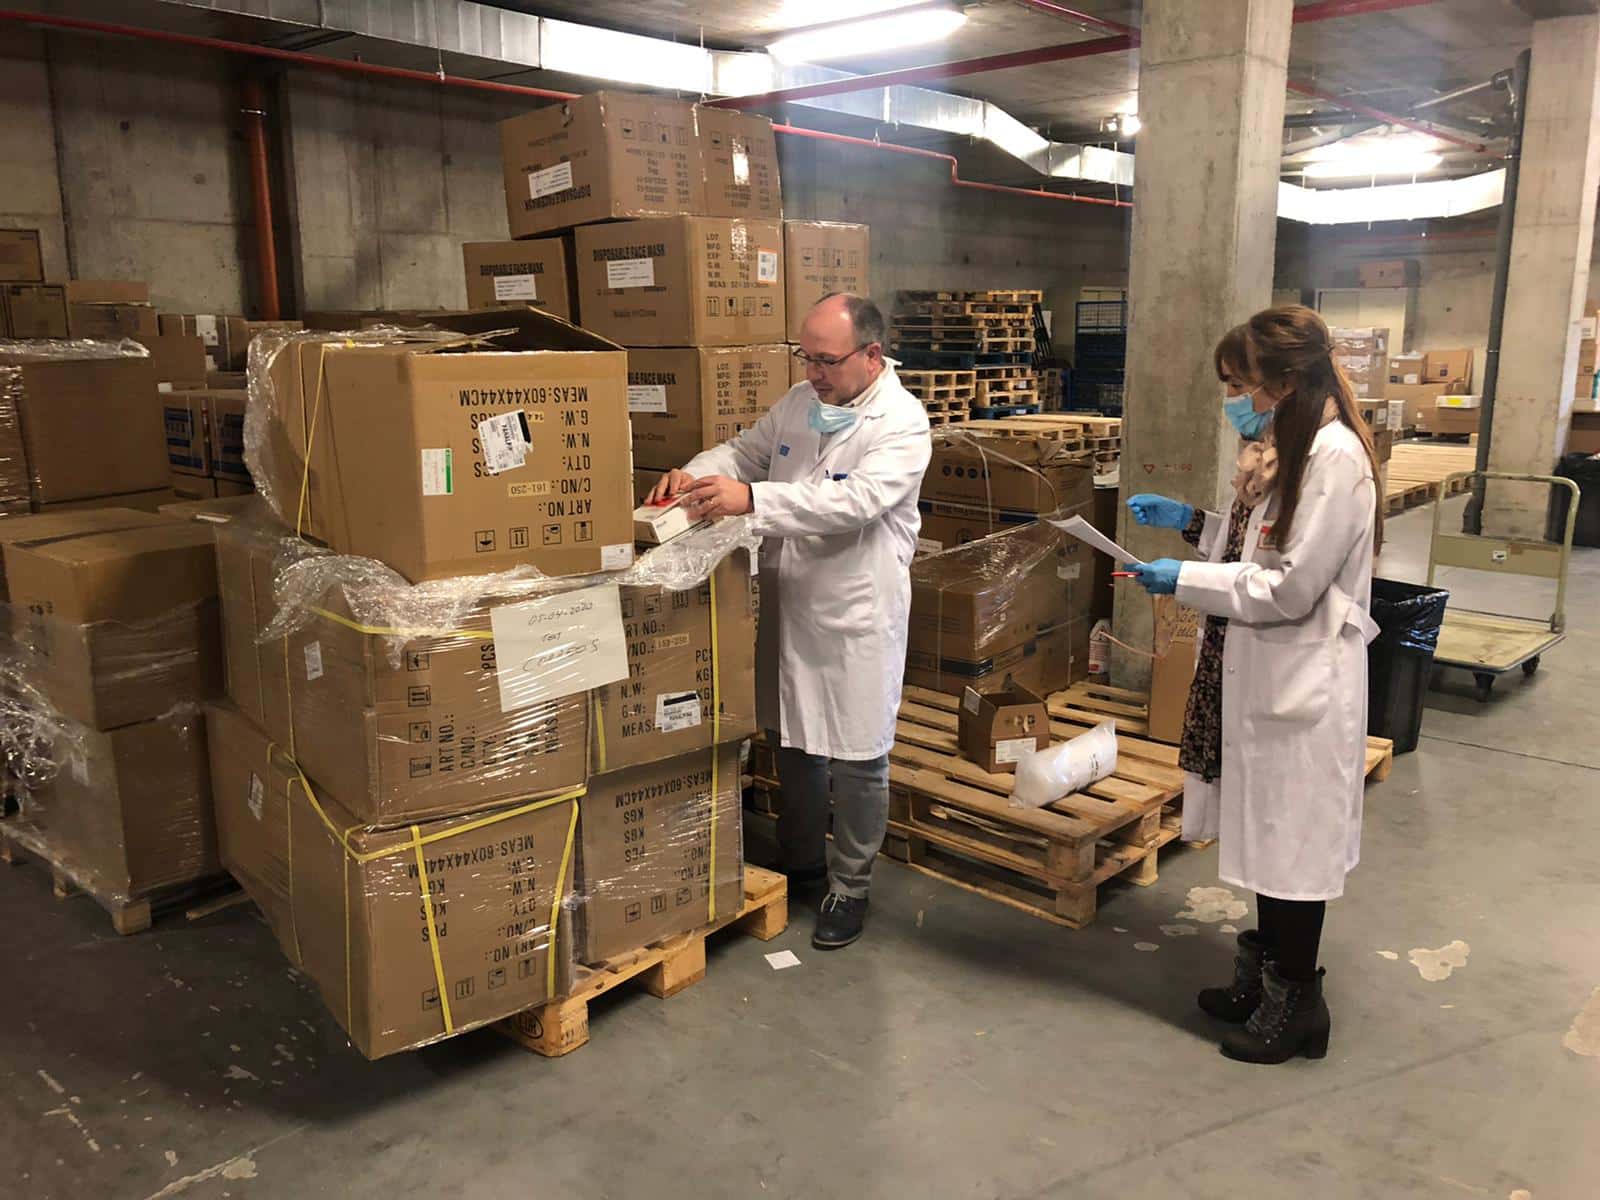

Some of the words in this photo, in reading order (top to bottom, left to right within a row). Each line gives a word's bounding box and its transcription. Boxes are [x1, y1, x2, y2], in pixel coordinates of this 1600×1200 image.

[459, 386, 588, 407] MEAS:60X44X44CM
[560, 409, 588, 426] G.W:
[561, 432, 590, 449] N.W:
[562, 455, 591, 471] QTY:
[567, 499, 592, 516] ART
[629, 662, 646, 678] TY:
[696, 667, 714, 682] KG
[697, 687, 714, 701] KG
[623, 807, 645, 823] KGS
[623, 827, 645, 844] KGS
